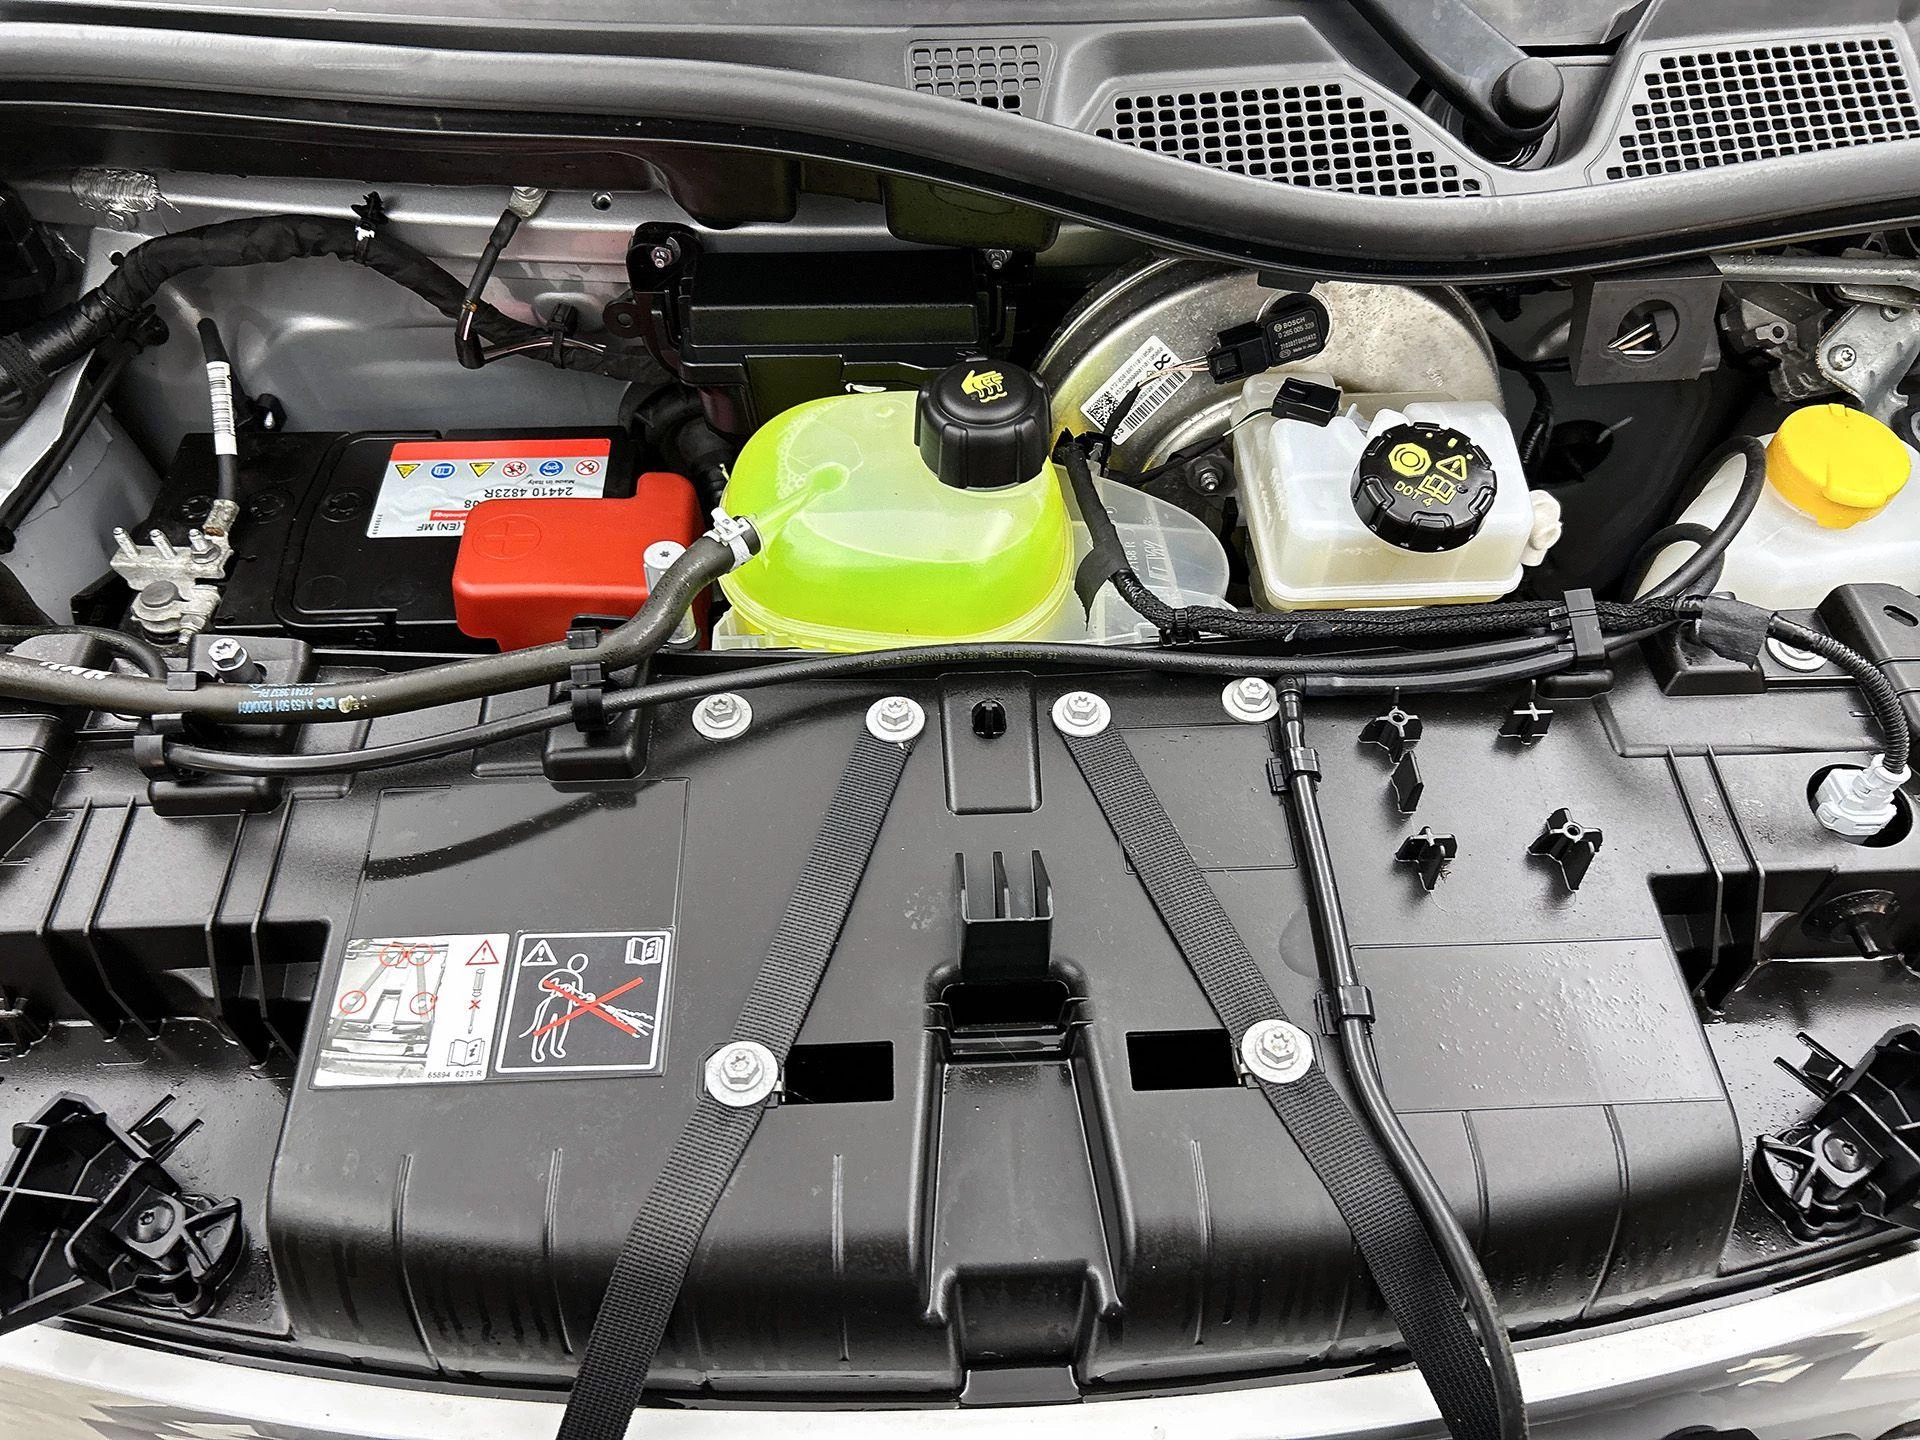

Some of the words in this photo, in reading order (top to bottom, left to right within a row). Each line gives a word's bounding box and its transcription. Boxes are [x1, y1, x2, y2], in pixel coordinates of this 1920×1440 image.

[1282, 316, 1306, 329] BOSCH
[484, 488, 527, 498] 4823R
[532, 487, 573, 497] 24410
[1393, 480, 1423, 501] DOT
[1421, 497, 1434, 508] 4
[416, 523, 434, 531] MF
[437, 522, 461, 531] (EN)
[985, 651, 1043, 660] TRELLEBORG
[427, 1071, 451, 1079] 65894
[455, 1070, 474, 1078] 6273
